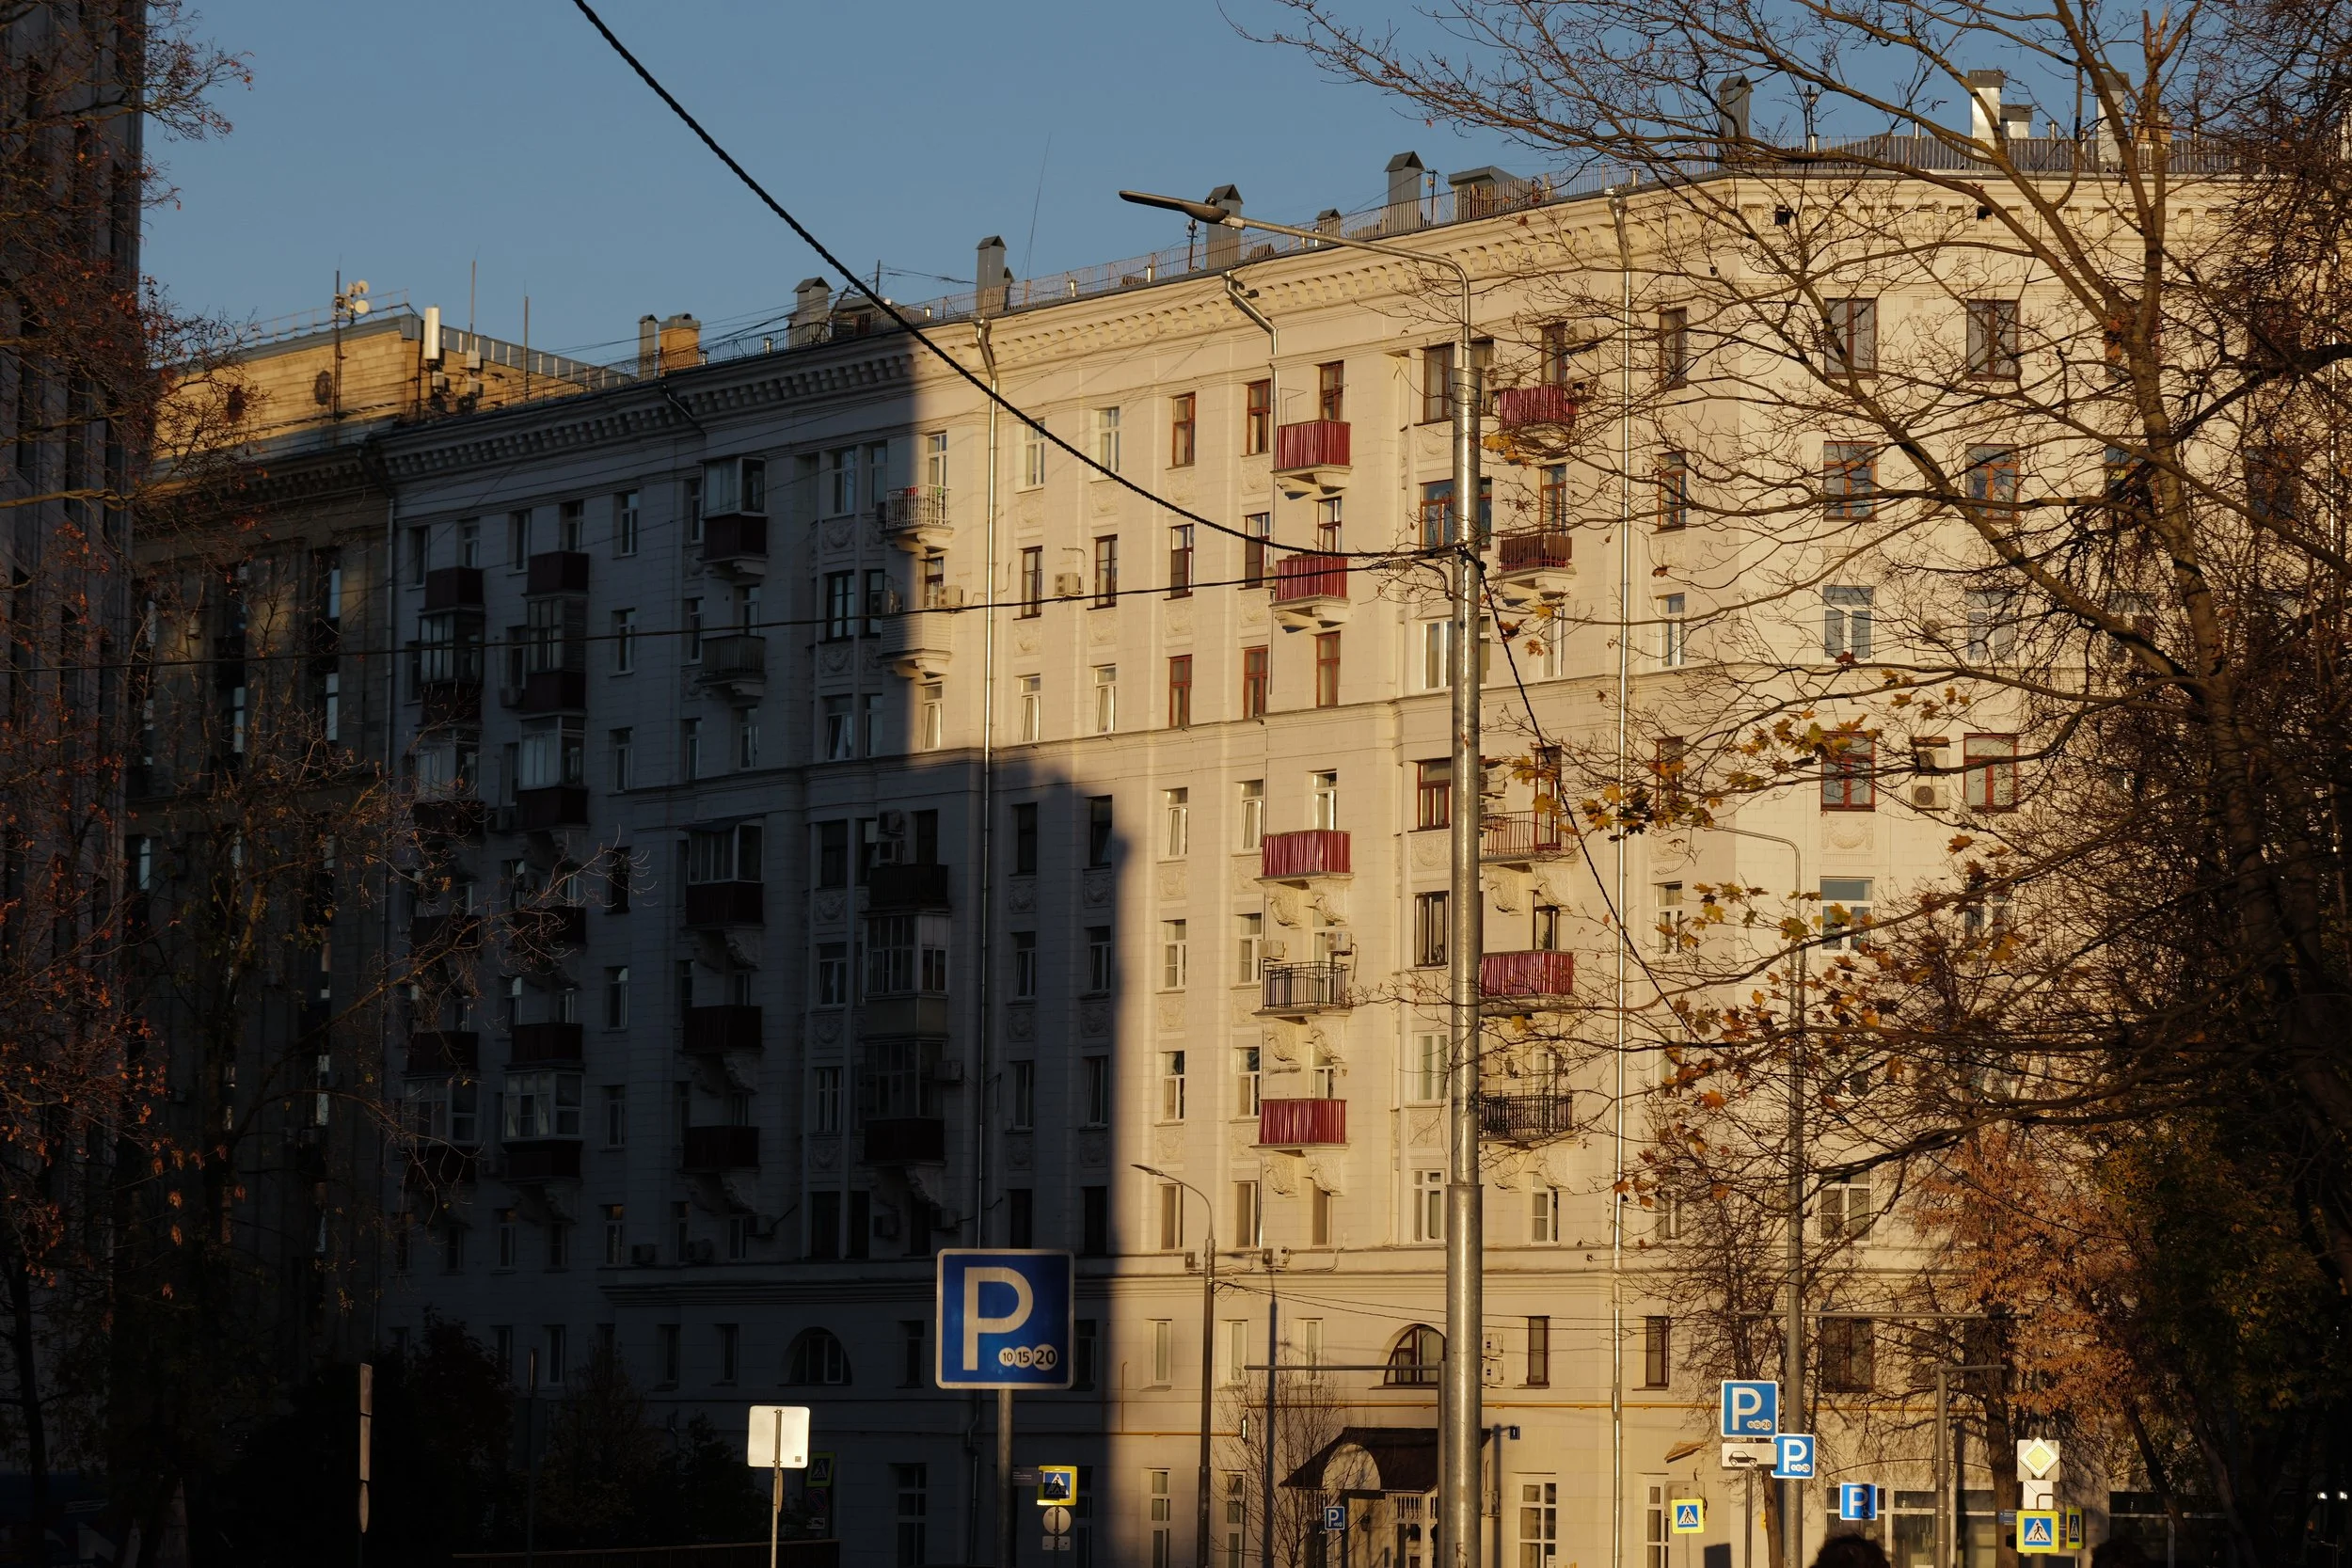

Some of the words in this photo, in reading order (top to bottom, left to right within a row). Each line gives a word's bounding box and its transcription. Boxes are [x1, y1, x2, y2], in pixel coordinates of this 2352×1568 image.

[963, 1266, 1034, 1370] P
[1003, 1352, 1013, 1362] 10
[1018, 1351, 1030, 1363] 15
[1036, 1349, 1057, 1365] 20
[1732, 1387, 1762, 1431] P
[1783, 1439, 1807, 1473] P
[1849, 1487, 1868, 1516] P
[1327, 1509, 1340, 1528] P
